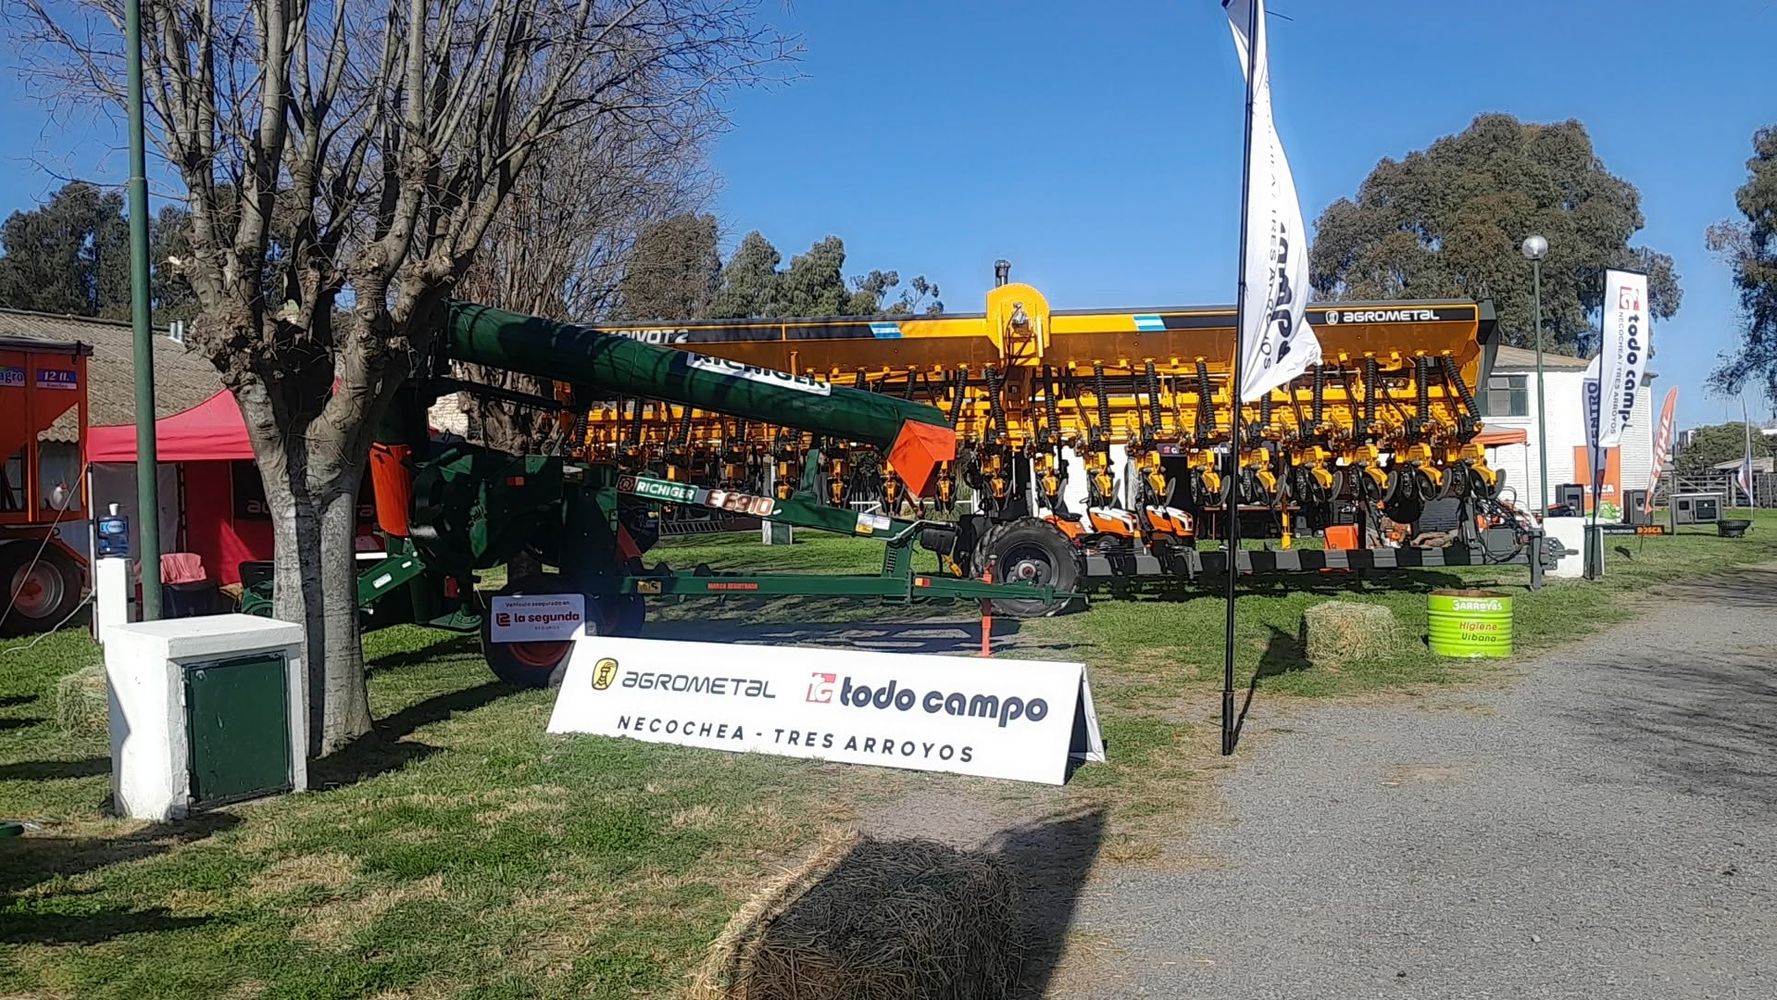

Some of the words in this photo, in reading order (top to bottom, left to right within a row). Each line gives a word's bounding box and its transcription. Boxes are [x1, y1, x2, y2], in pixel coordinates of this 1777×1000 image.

[1271, 222, 1293, 364] amp
[675, 329, 689, 344] 2
[1617, 312, 1625, 360] NECOCHEA
[1627, 314, 1641, 365] todo
[44, 371, 57, 381] 12
[1614, 366, 1623, 389] TRES
[1610, 390, 1619, 434] ARROYOS
[636, 481, 695, 501] RICHIGER
[706, 490, 721, 507] E
[514, 612, 526, 623] la
[528, 611, 580, 625] segunda
[1459, 621, 1498, 632] Higiene
[1461, 632, 1497, 642] Urbana
[840, 676, 916, 711] todo
[922, 690, 1049, 728] campo
[617, 715, 744, 740] NECOCHEA
[774, 728, 834, 748] TRES
[844, 735, 973, 763] ARROYOS
